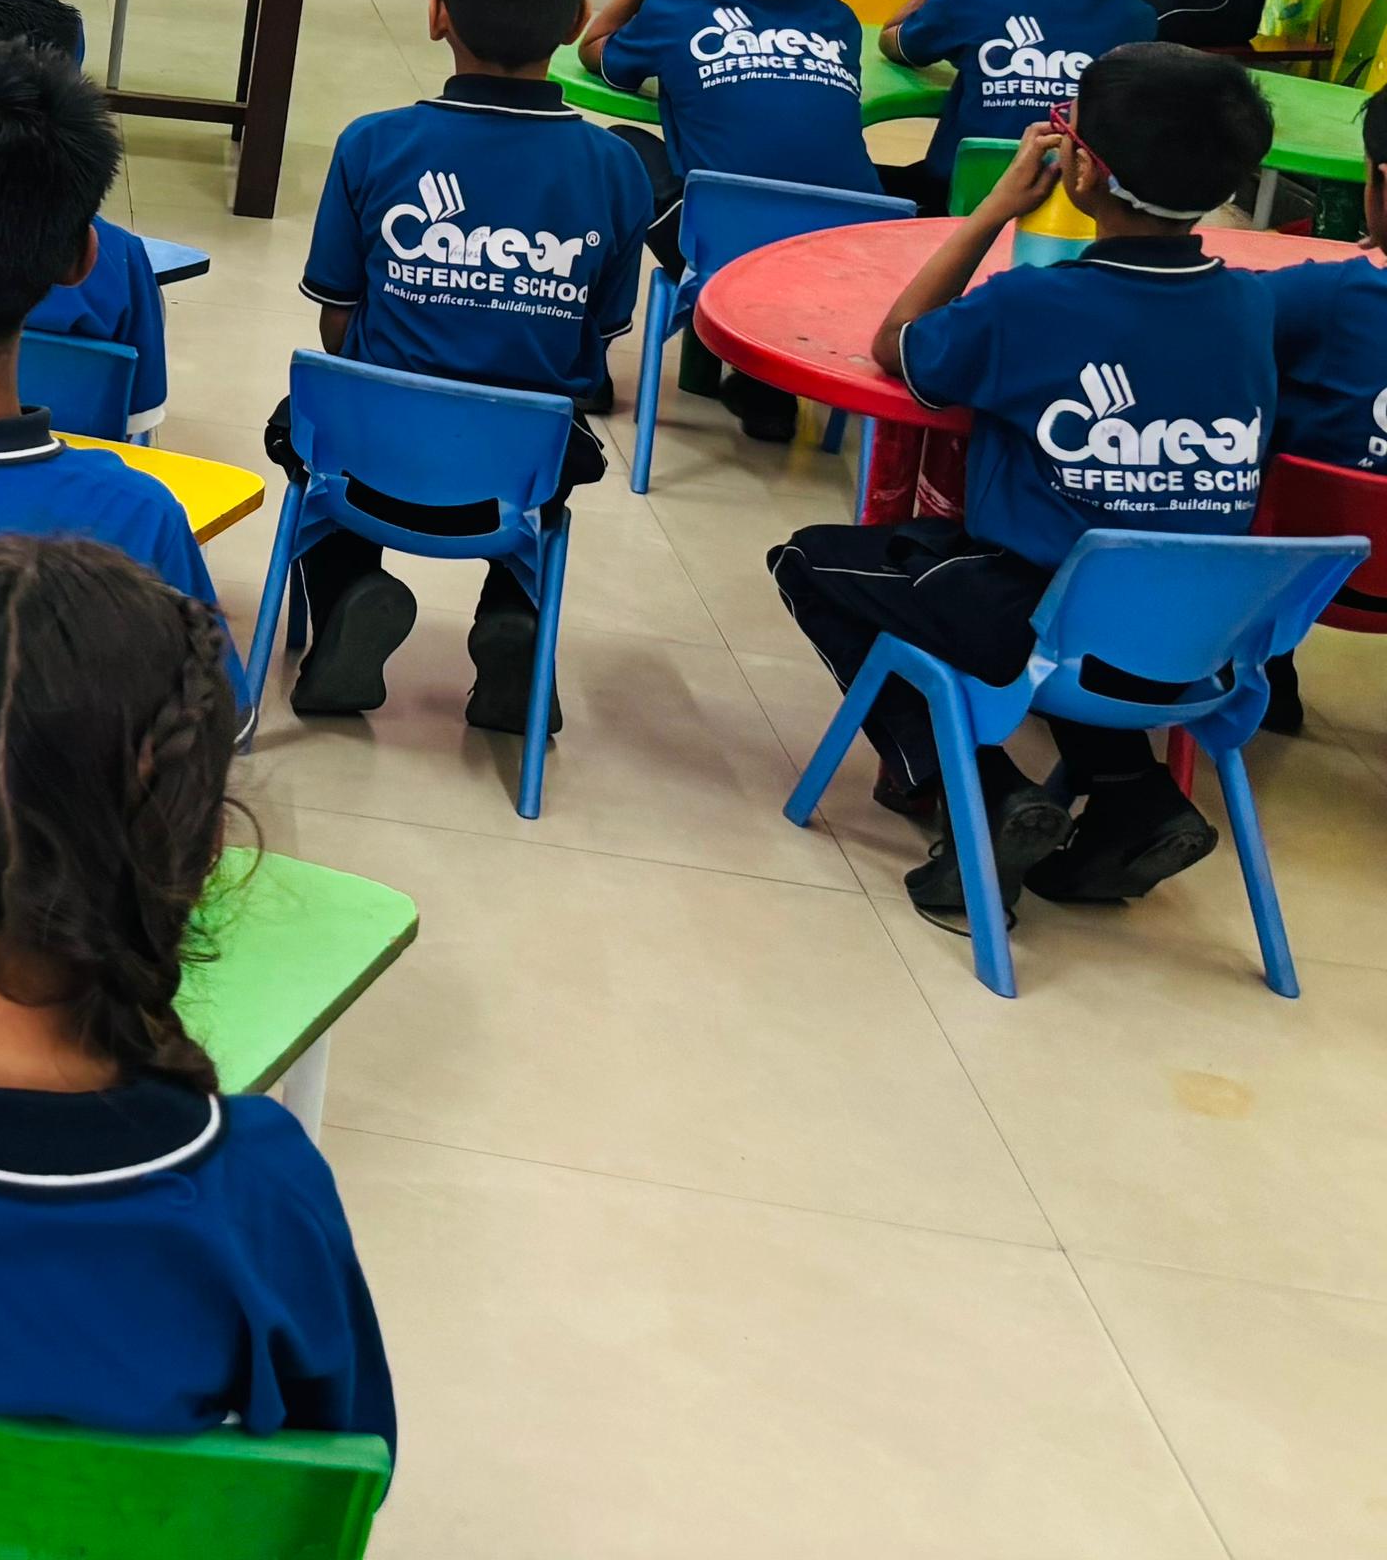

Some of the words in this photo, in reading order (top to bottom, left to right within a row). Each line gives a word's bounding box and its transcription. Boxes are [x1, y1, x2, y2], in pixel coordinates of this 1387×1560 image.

[698, 55, 797, 80] DEFENCE
[702, 74, 738, 90] Making
[982, 80, 1080, 97] DEFENCE
[982, 98, 1018, 108] Making
[387, 260, 505, 292] DEFENCE
[384, 282, 427, 304] Making
[1054, 465, 1184, 492] EFENCE
